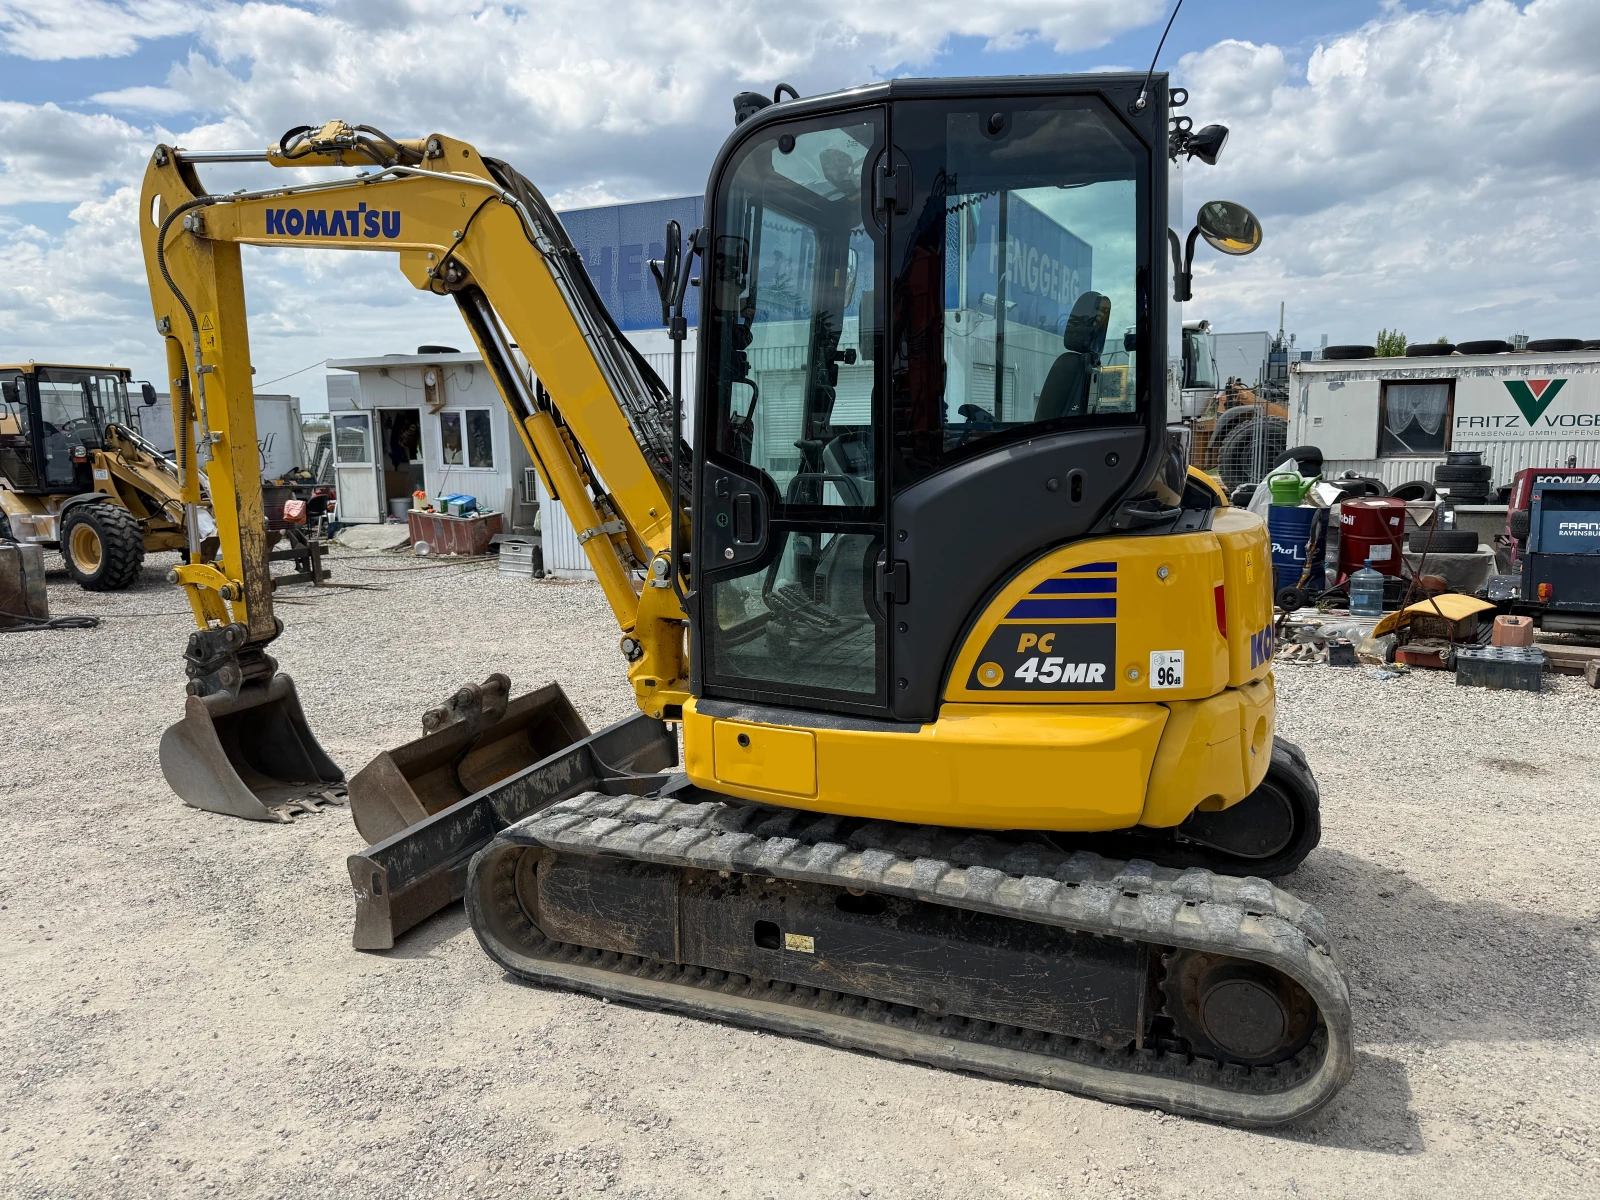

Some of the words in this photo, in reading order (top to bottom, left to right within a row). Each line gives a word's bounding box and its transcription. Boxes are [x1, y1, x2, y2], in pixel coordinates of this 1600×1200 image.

[266, 202, 401, 239] KOMATSU
[1456, 415, 1520, 428] FRITZ
[1340, 512, 1355, 526] obil
[1559, 522, 1600, 530] FRAN
[1016, 632, 1056, 654] PC
[1250, 622, 1275, 671] KO
[1014, 656, 1107, 684] 45MR
